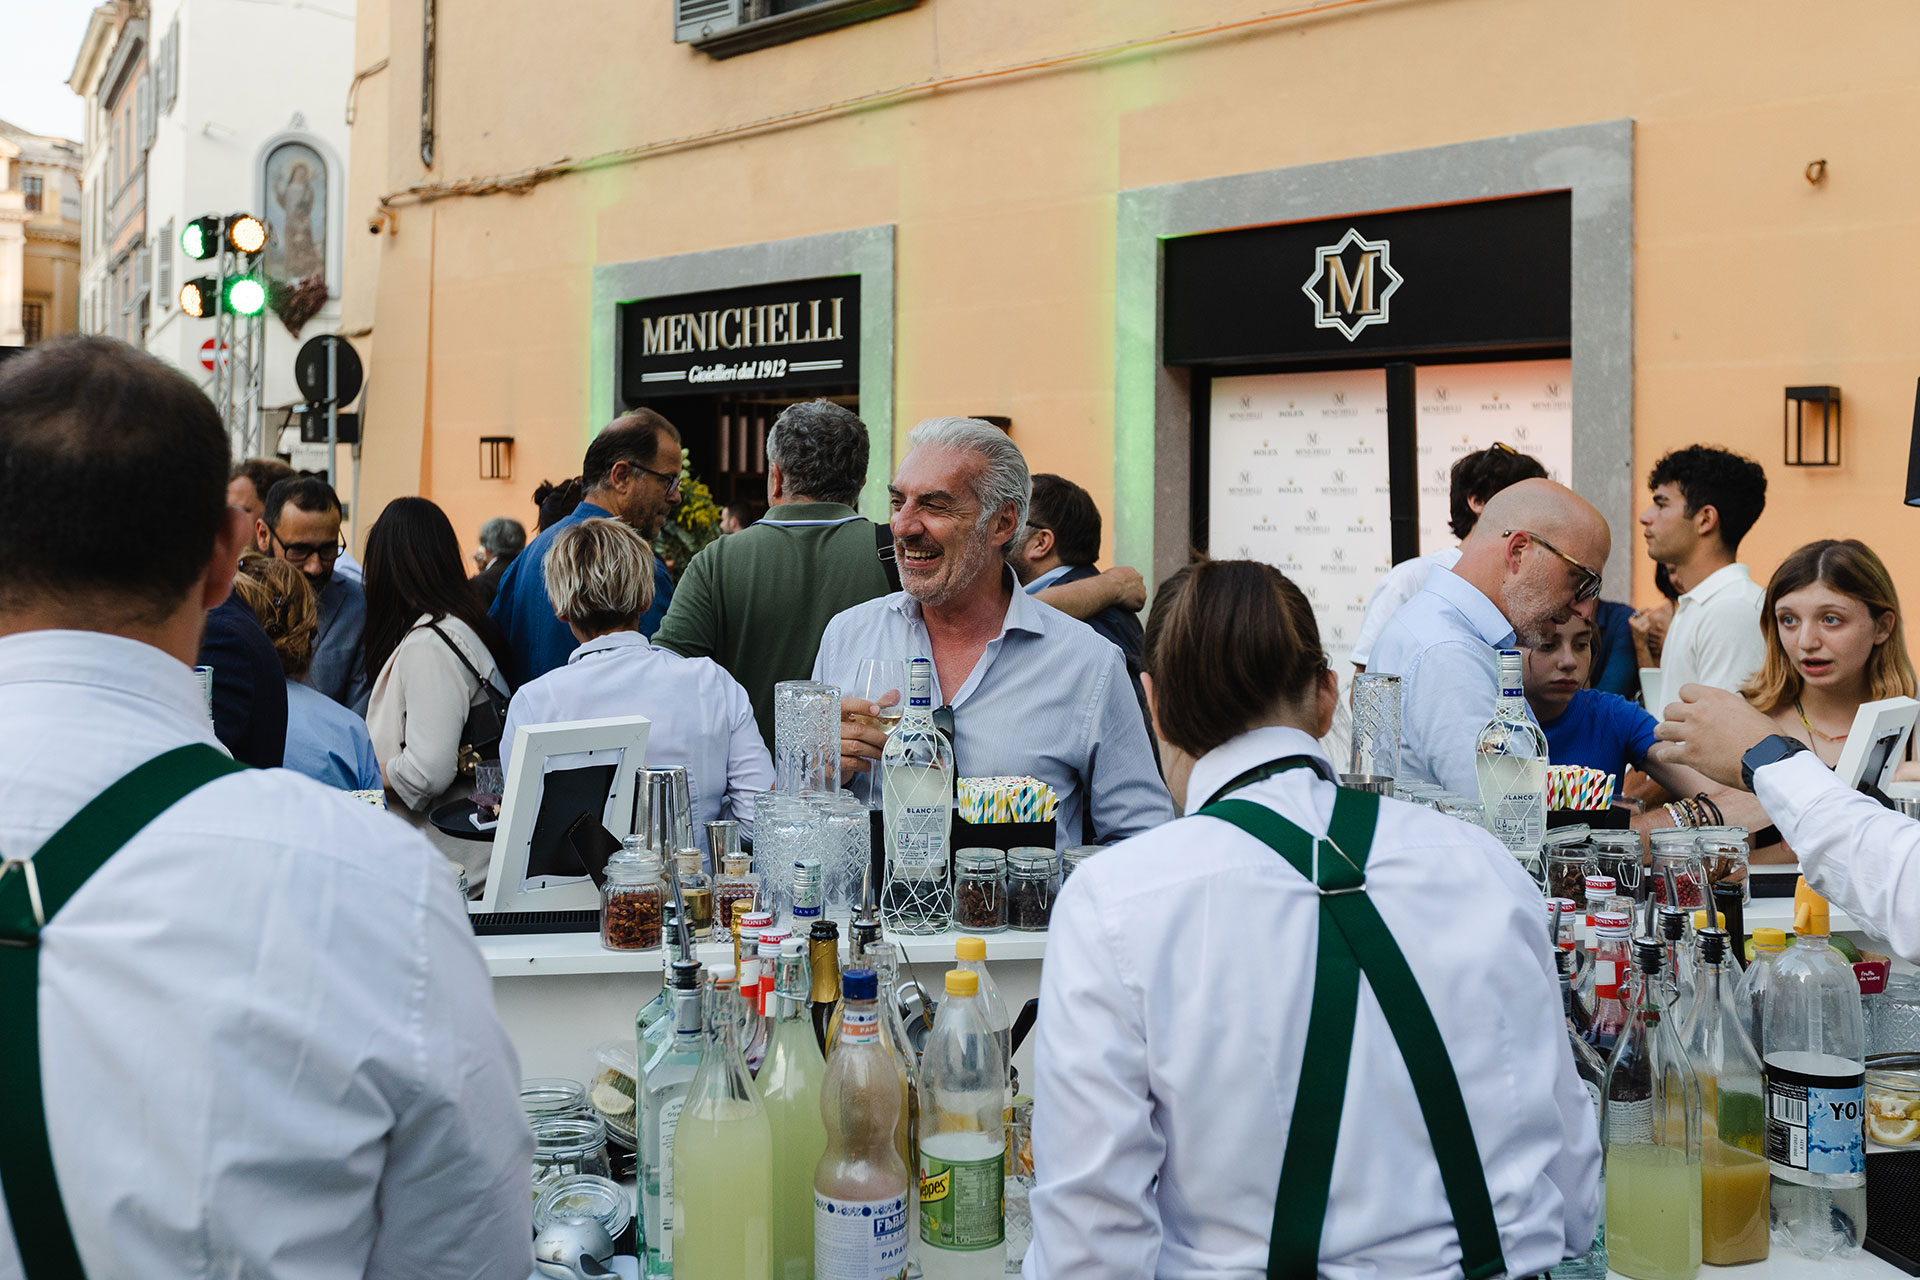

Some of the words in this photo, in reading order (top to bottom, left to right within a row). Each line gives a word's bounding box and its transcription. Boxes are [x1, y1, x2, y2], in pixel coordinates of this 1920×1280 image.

[1324, 250, 1381, 317] M
[641, 297, 844, 356] MENICHELLI
[688, 363, 737, 384] Gioiellieri
[737, 361, 757, 380] dal
[757, 359, 787, 379] 1912
[1481, 403, 1511, 411] ROLEX
[920, 1179, 946, 1200] eppes
